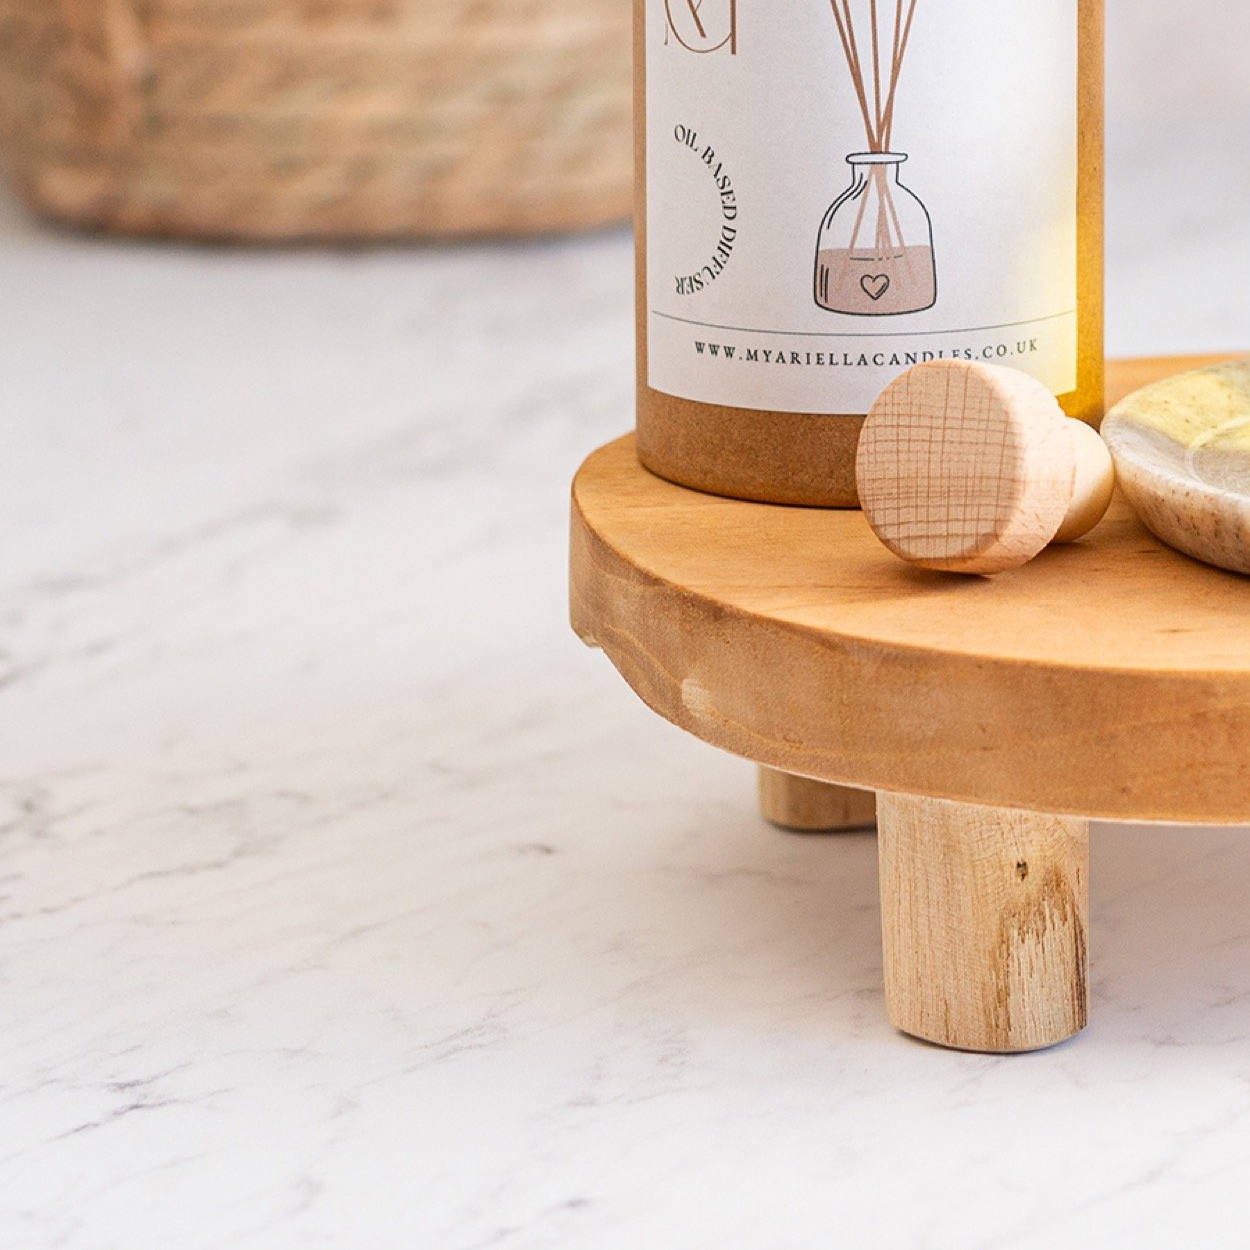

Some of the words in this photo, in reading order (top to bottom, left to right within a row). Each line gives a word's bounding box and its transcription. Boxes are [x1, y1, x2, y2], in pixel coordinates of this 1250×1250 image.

[674, 124, 699, 152] OIL
[701, 146, 737, 221] BASED
[674, 225, 737, 295] DIFFUSER
